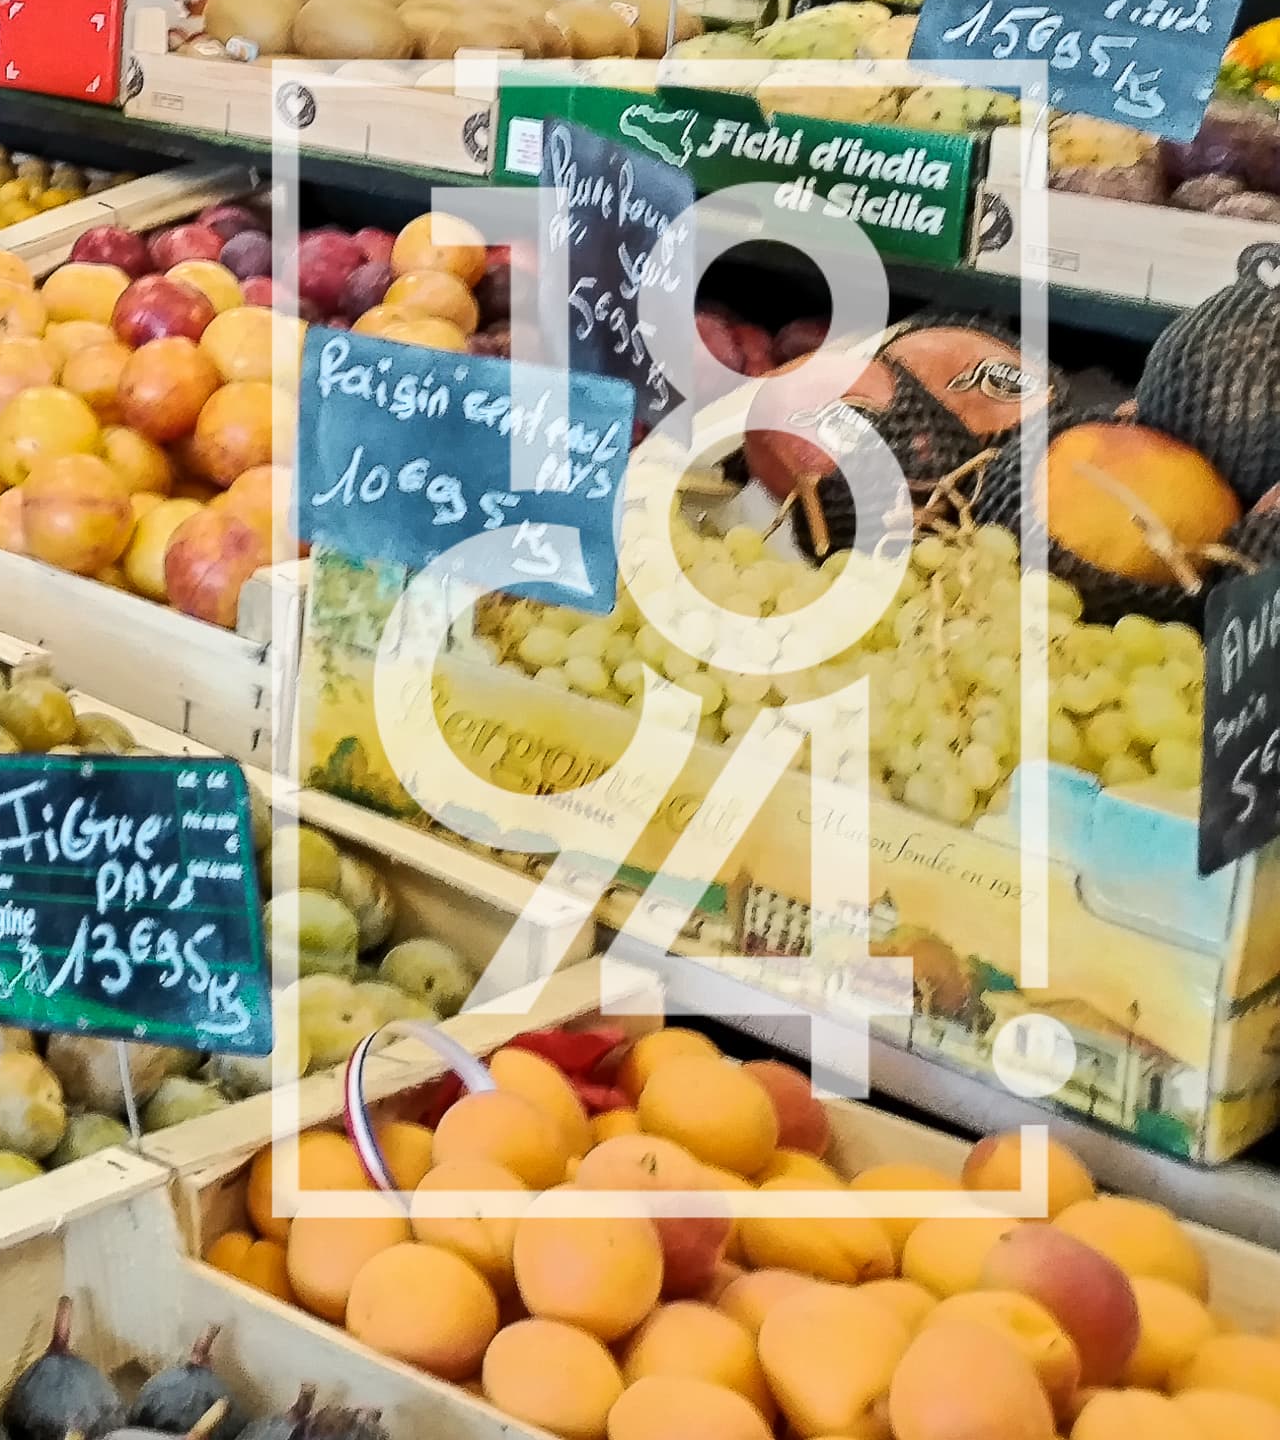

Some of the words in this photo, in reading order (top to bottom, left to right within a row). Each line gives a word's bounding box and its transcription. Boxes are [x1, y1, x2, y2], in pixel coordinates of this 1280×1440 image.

[697, 120, 804, 166] Fichi
[808, 135, 952, 191] d'india
[773, 175, 817, 213] di
[821, 182, 948, 236] Sicilia
[960, 869, 984, 887] en
